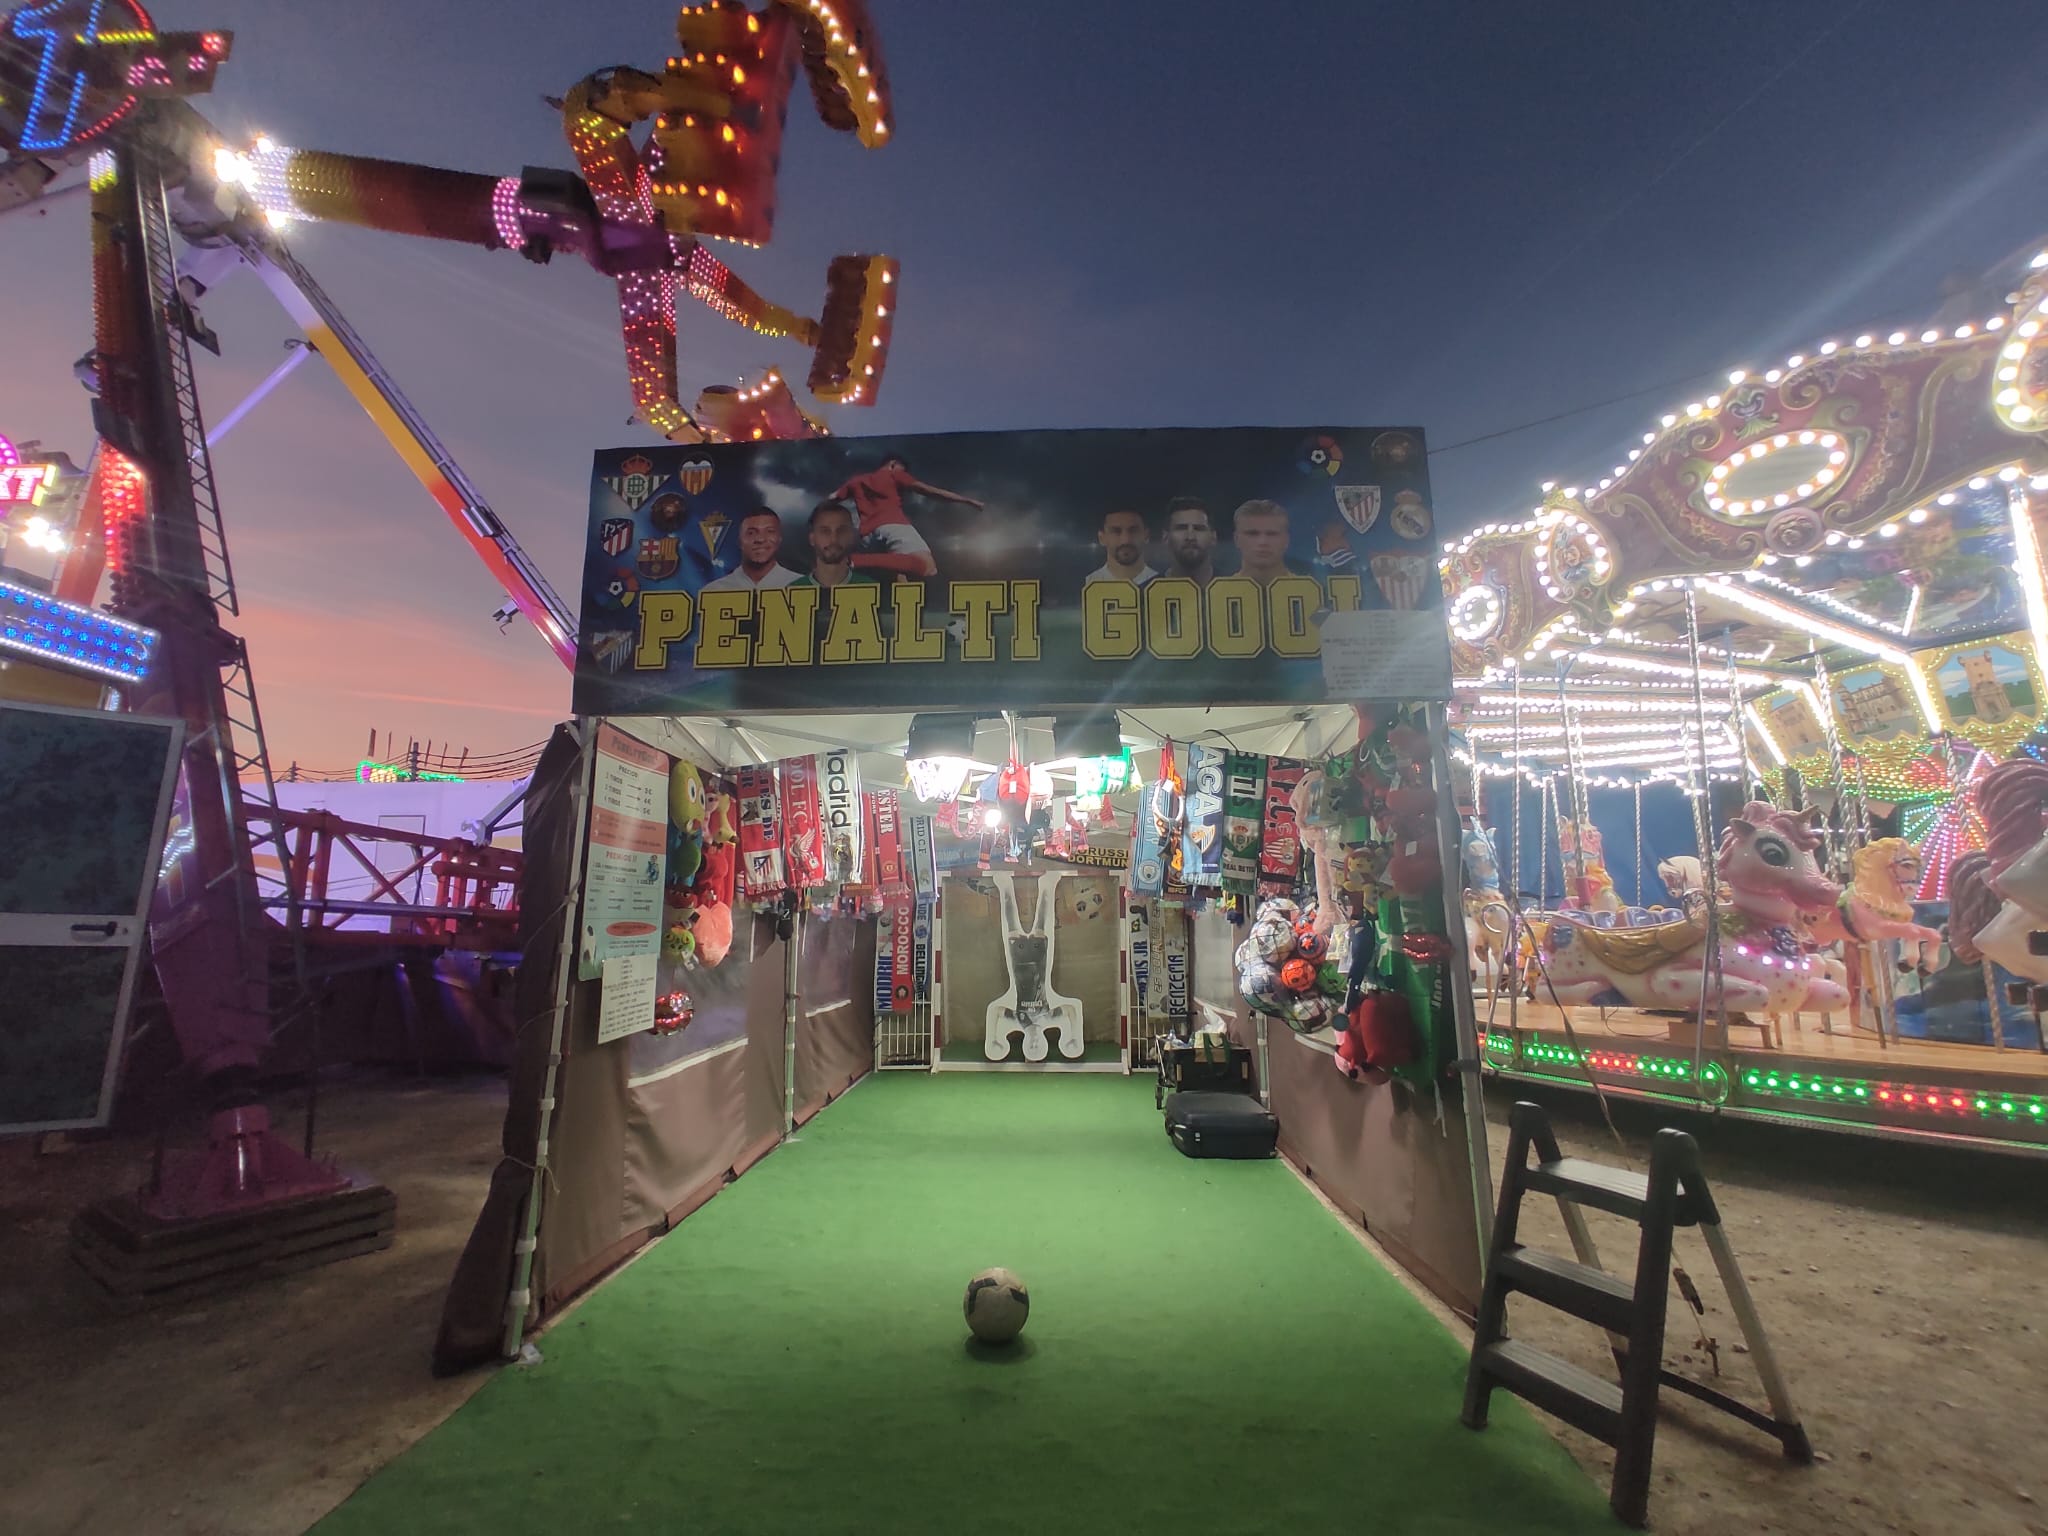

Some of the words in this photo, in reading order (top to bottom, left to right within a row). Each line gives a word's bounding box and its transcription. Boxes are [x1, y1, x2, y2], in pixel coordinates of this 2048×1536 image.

[634, 579, 1041, 670] PENALTI
[792, 800, 807, 824] FC
[877, 789, 894, 834] ESTER
[896, 906, 910, 975] MOROCCO
[1133, 940, 1149, 957] JR
[1168, 954, 1188, 1016] BENZEMA
